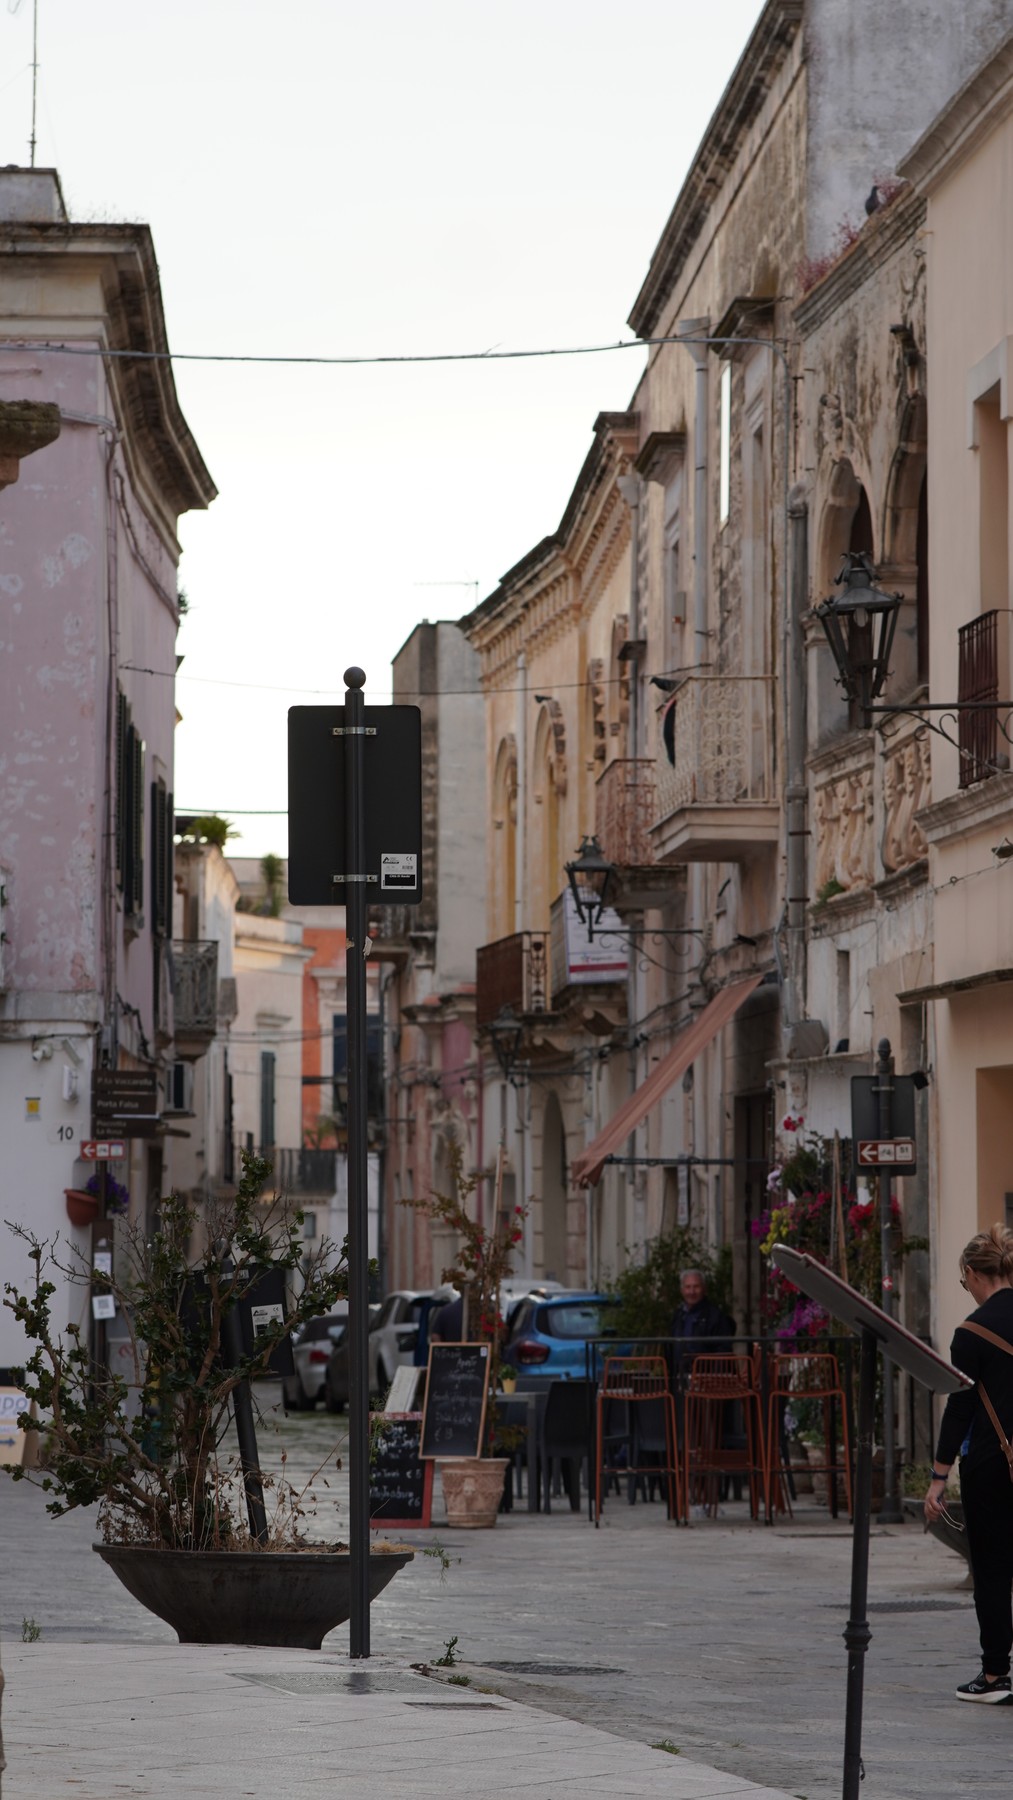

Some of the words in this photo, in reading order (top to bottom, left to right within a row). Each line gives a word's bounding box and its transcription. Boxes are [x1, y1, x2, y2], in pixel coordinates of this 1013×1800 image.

[97, 1100, 118, 1108] Porta
[57, 1124, 74, 1141] 10
[0, 1396, 28, 1411] DO
